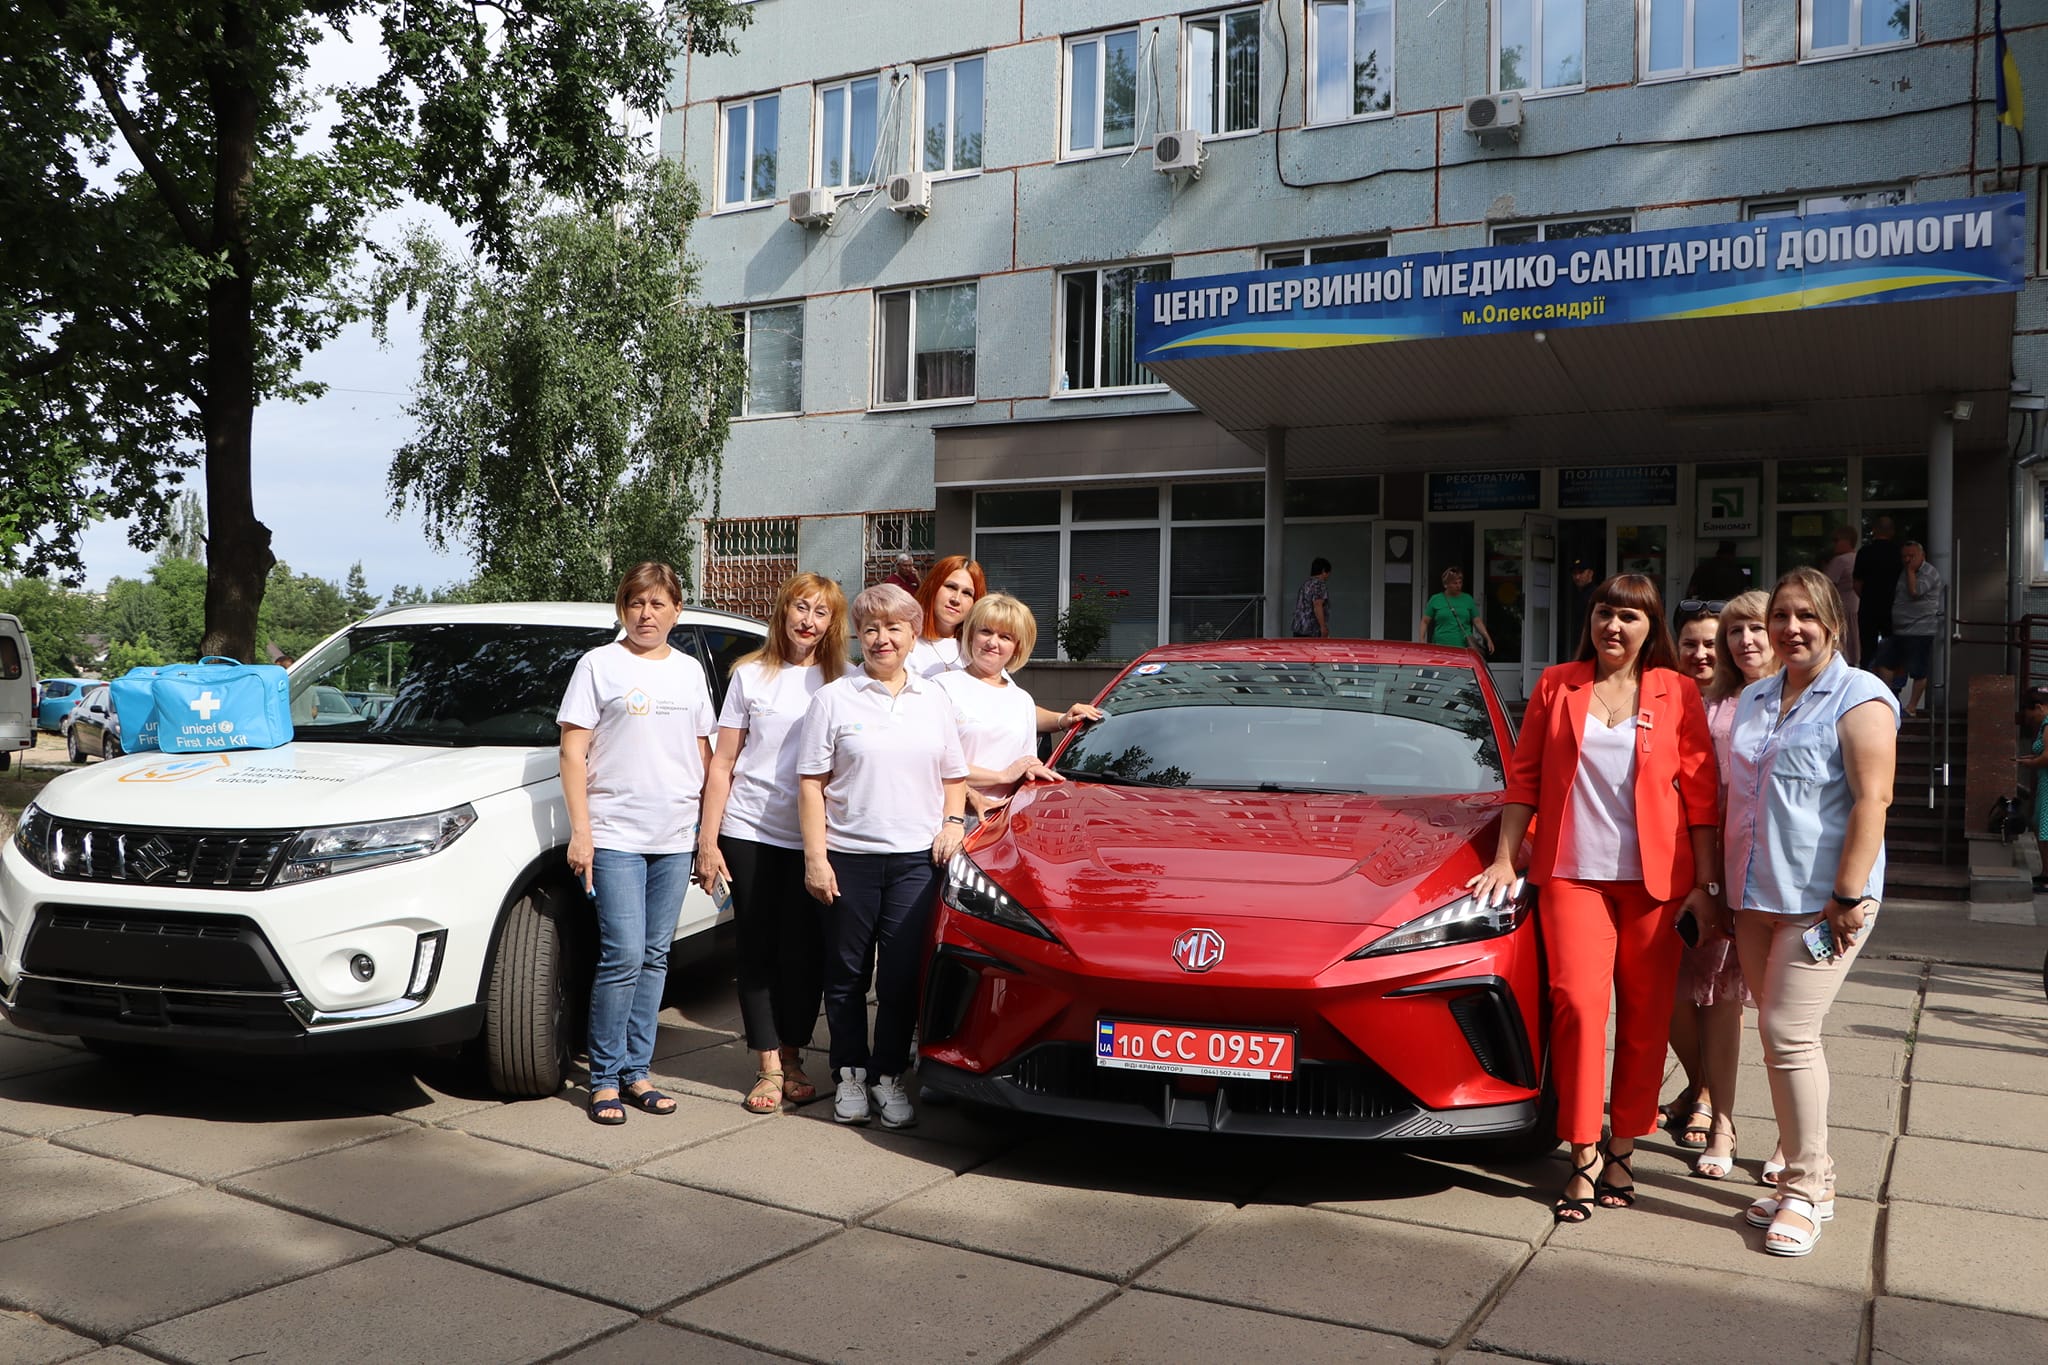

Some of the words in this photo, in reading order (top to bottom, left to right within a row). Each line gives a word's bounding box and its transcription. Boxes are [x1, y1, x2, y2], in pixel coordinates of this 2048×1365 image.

[1153, 286, 1239, 326] ЦЕНТР
[1248, 261, 1414, 314] ПЕРВИННОЇ
[1423, 226, 1769, 298] МЕДИКО-САНІТАРНОЇ
[1776, 210, 1994, 271] ДОПОМОГИ
[1461, 295, 1606, 326] м.Олександрії
[1446, 472, 1526, 485] РЕЄСТРАТУРА
[1703, 521, 1752, 531] Банкомат
[182, 722, 217, 735] unicef
[139, 734, 159, 745] Firs
[176, 736, 202, 748] First
[206, 736, 226, 747] Aid
[229, 734, 249, 746] Kit
[1177, 932, 1220, 968] MG
[1100, 1043, 1112, 1053] UA
[1117, 1034, 1145, 1057] 10
[1151, 1029, 1198, 1060] CC
[1207, 1033, 1286, 1067] 0957
